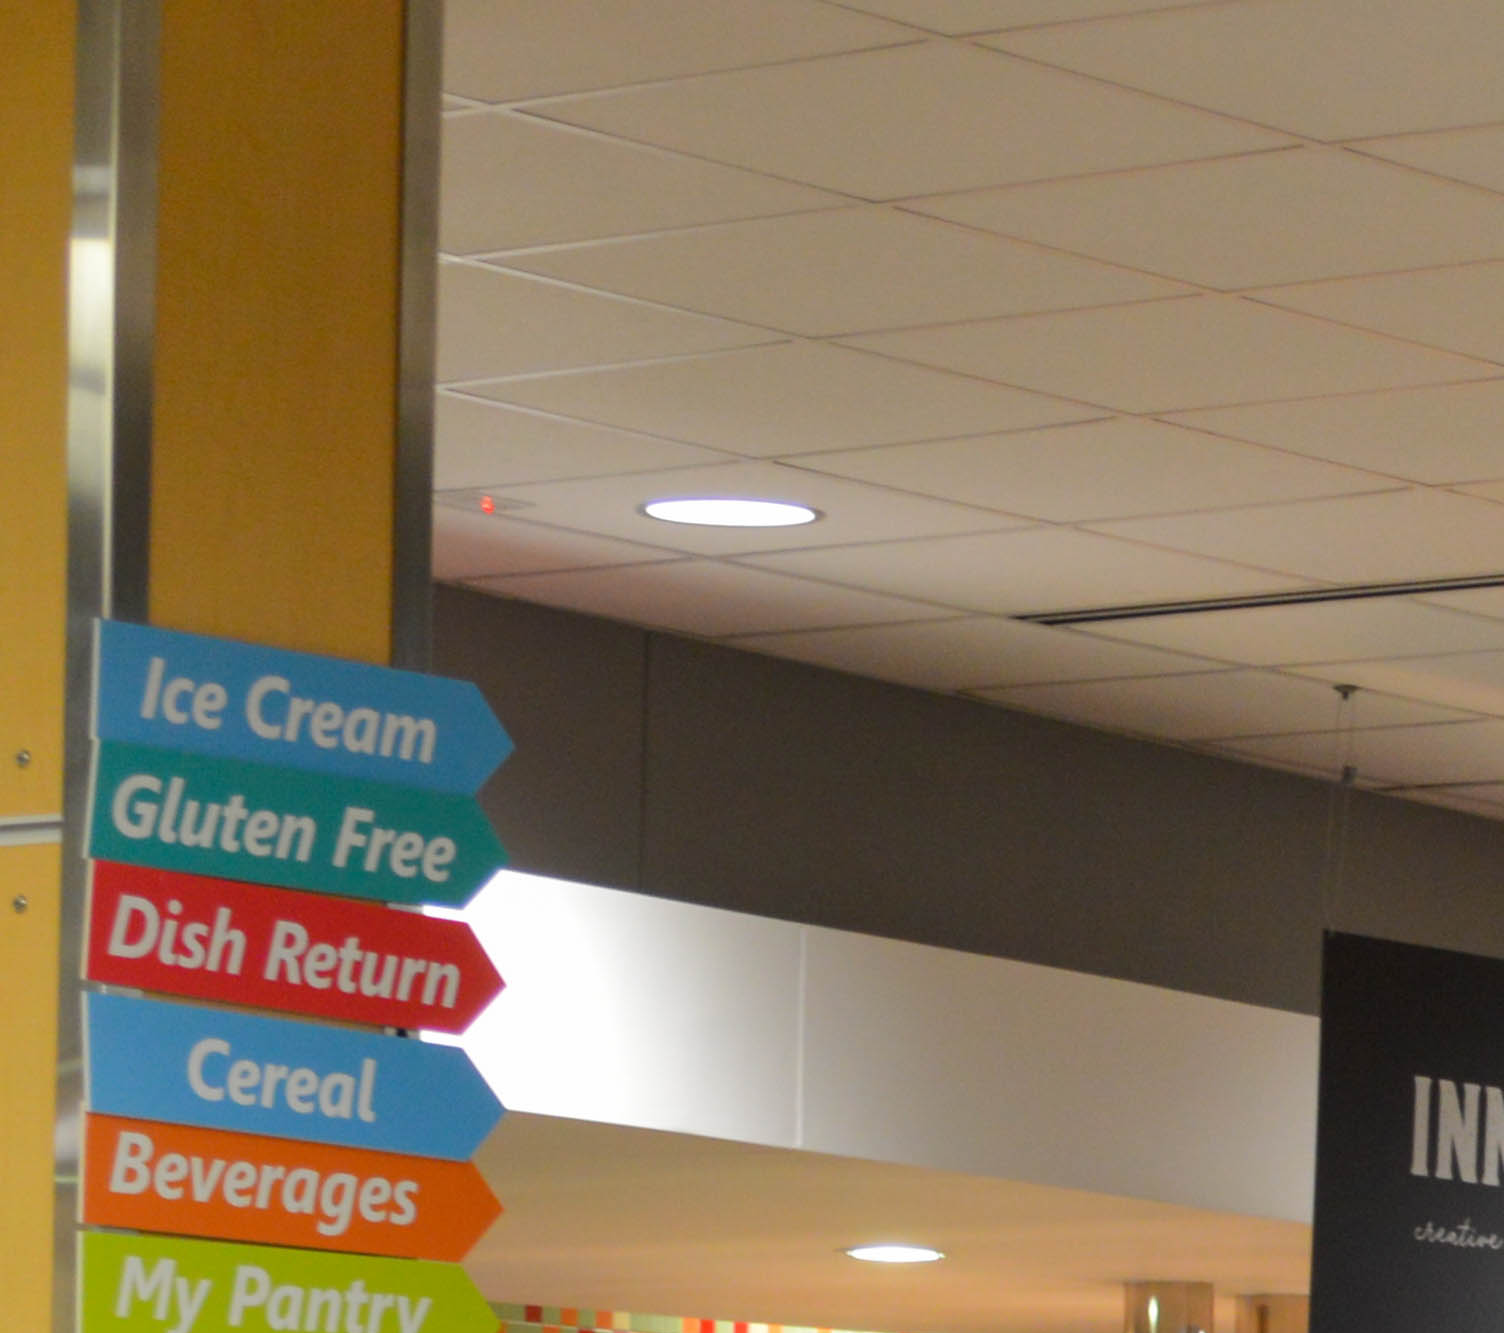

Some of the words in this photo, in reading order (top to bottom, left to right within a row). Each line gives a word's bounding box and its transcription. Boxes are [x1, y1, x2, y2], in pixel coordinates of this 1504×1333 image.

[139, 657, 227, 730] Ice
[245, 675, 437, 764] Cream
[110, 773, 314, 864] Gluten
[331, 805, 457, 884] Free
[108, 893, 246, 976] Dish
[263, 920, 462, 1010] Return
[186, 1037, 377, 1123] Cereal
[108, 1130, 419, 1238] Beverages
[1413, 1217, 1504, 1250] creative
